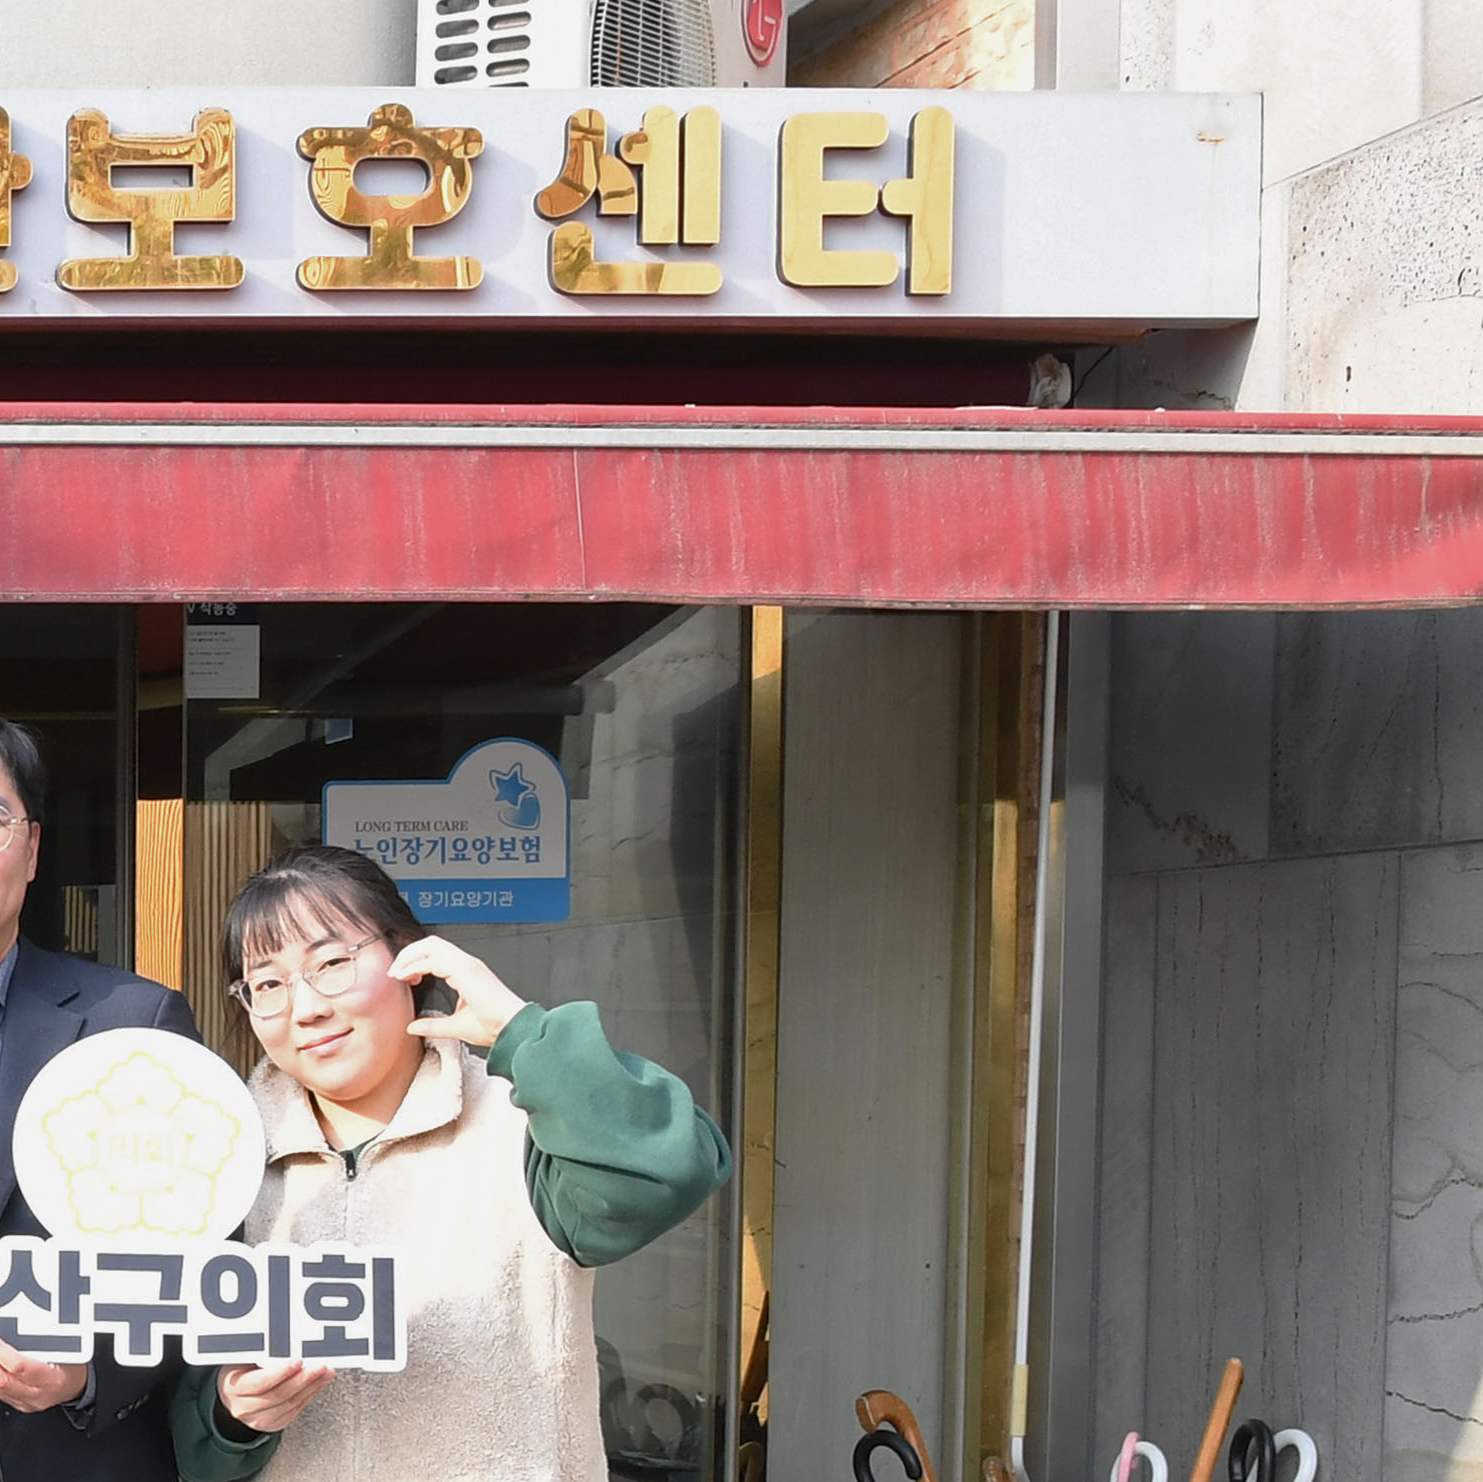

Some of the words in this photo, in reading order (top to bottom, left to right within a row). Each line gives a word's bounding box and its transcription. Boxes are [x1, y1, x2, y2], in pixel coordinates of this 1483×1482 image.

[355, 821, 392, 833] LONG
[394, 820, 431, 832] TERM
[433, 820, 468, 832] CARE
[418, 891, 514, 907] 장기요양기관
